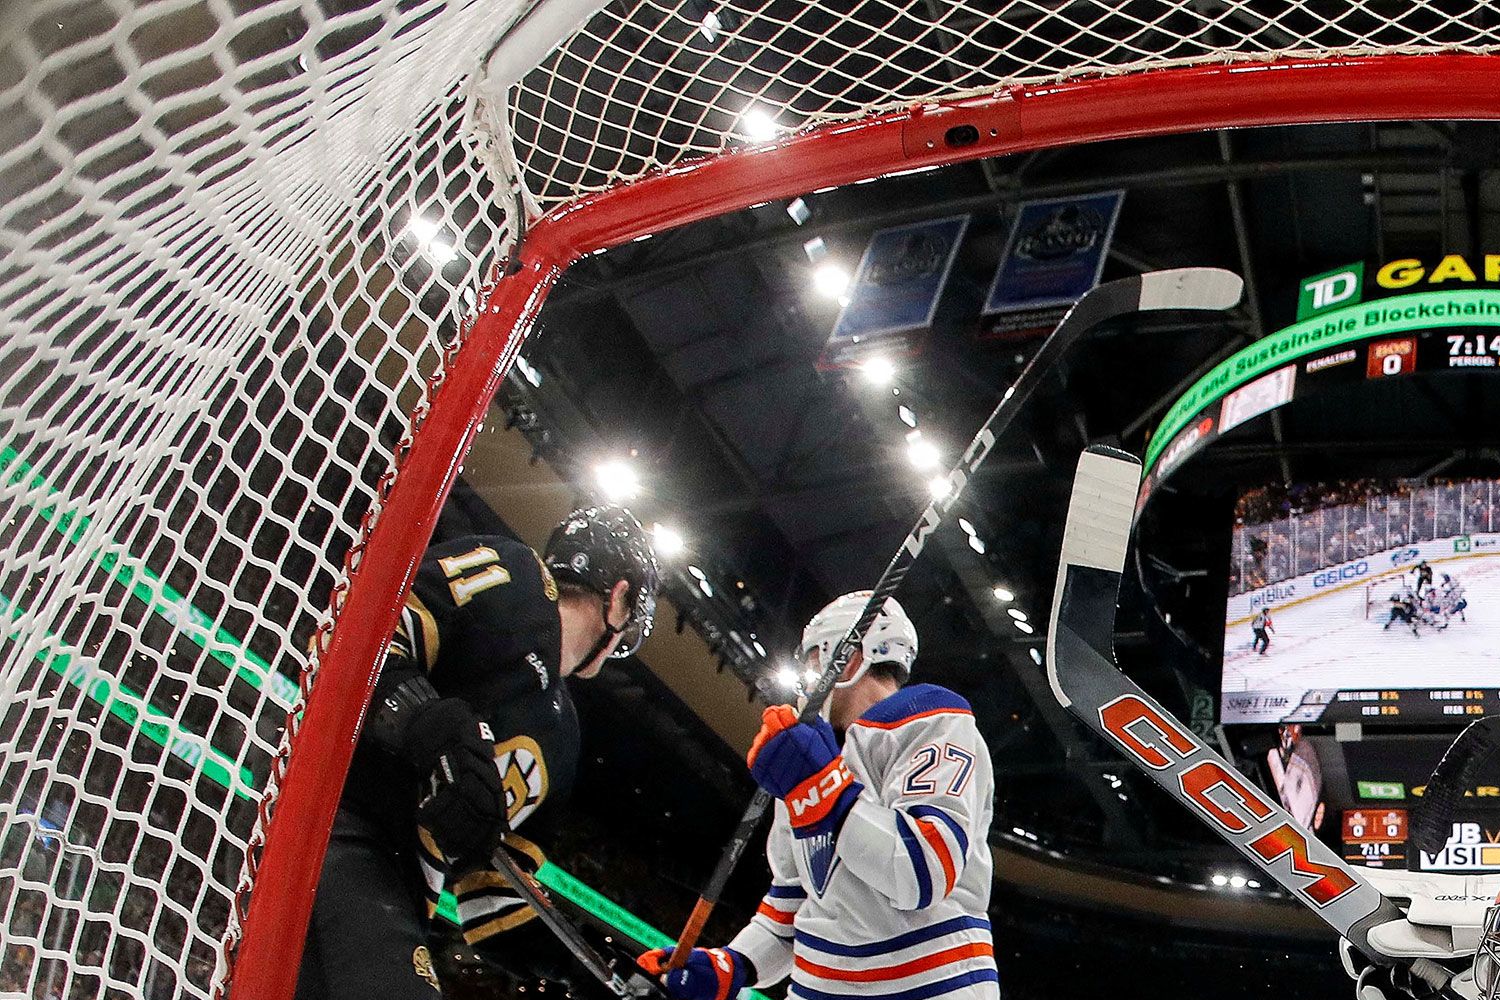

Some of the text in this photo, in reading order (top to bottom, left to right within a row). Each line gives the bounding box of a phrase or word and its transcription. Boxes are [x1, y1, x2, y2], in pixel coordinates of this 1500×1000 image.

[1305, 271, 1358, 310] TD
[1234, 316, 1357, 376] Sustainable
[1383, 354, 1402, 376] 0
[437, 545, 512, 608] 11
[1313, 561, 1369, 588] GEICO
[1250, 584, 1296, 614] jetBlue
[903, 742, 976, 797] 27
[1097, 693, 1361, 909] CCM
[1352, 825, 1364, 838] 0
[1387, 825, 1398, 838] 0
[1359, 843, 1391, 857] 7:14
